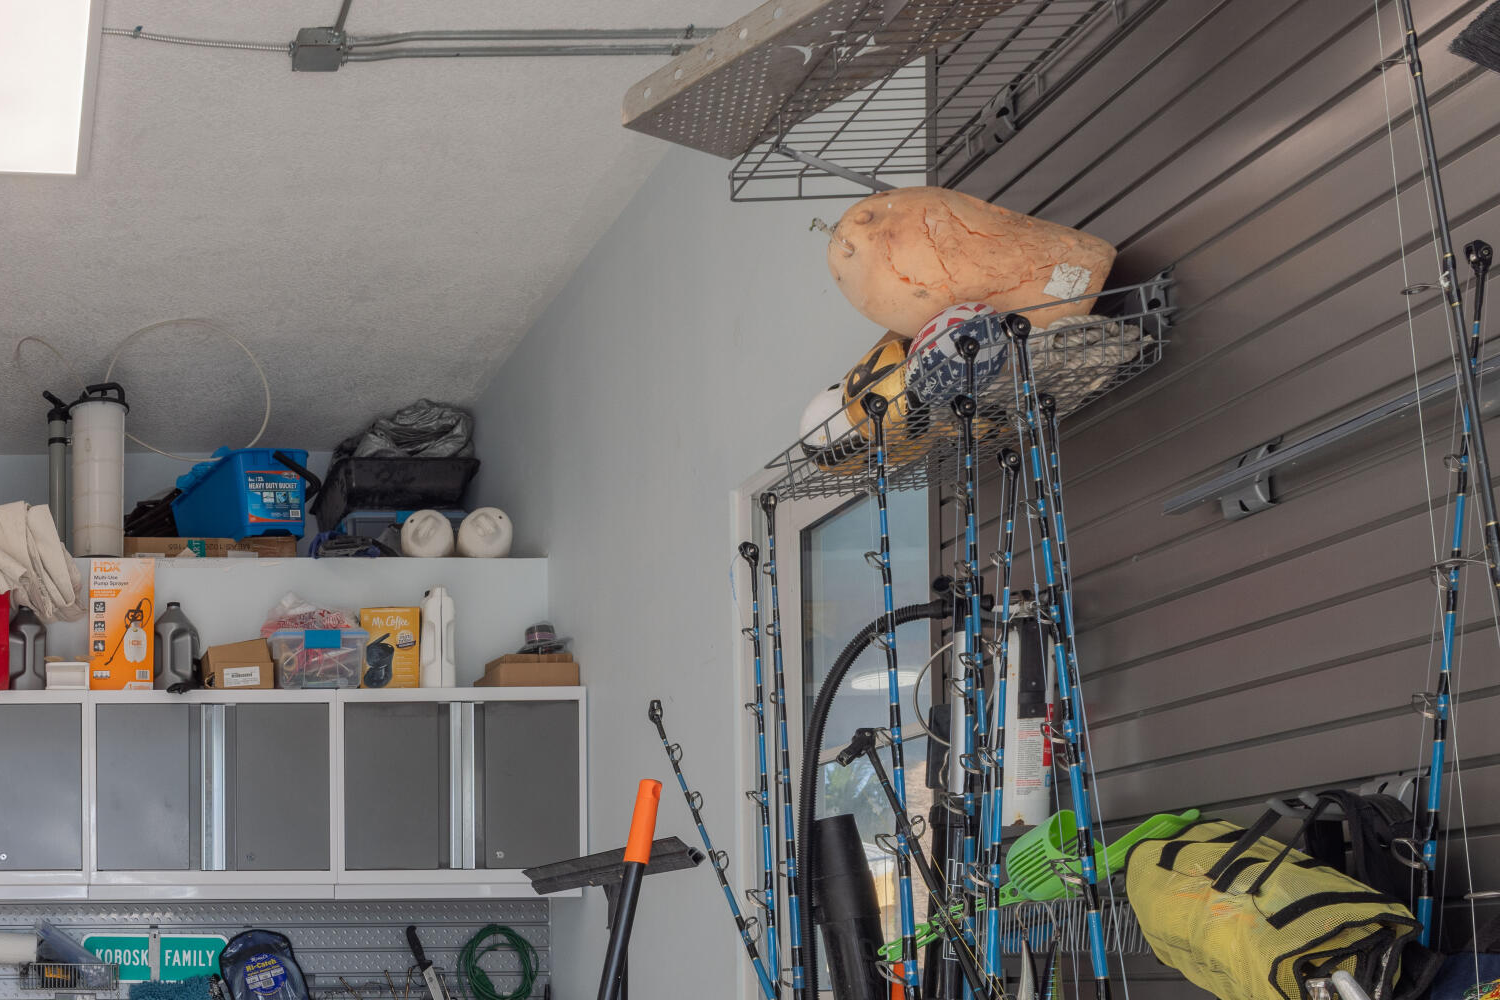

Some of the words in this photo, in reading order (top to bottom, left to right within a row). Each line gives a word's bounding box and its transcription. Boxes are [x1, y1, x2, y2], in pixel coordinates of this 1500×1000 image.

[93, 561, 120, 573] HDX
[386, 615, 410, 631] Coffee
[95, 948, 150, 967] KOBOSK
[164, 949, 216, 967] FAMILY
